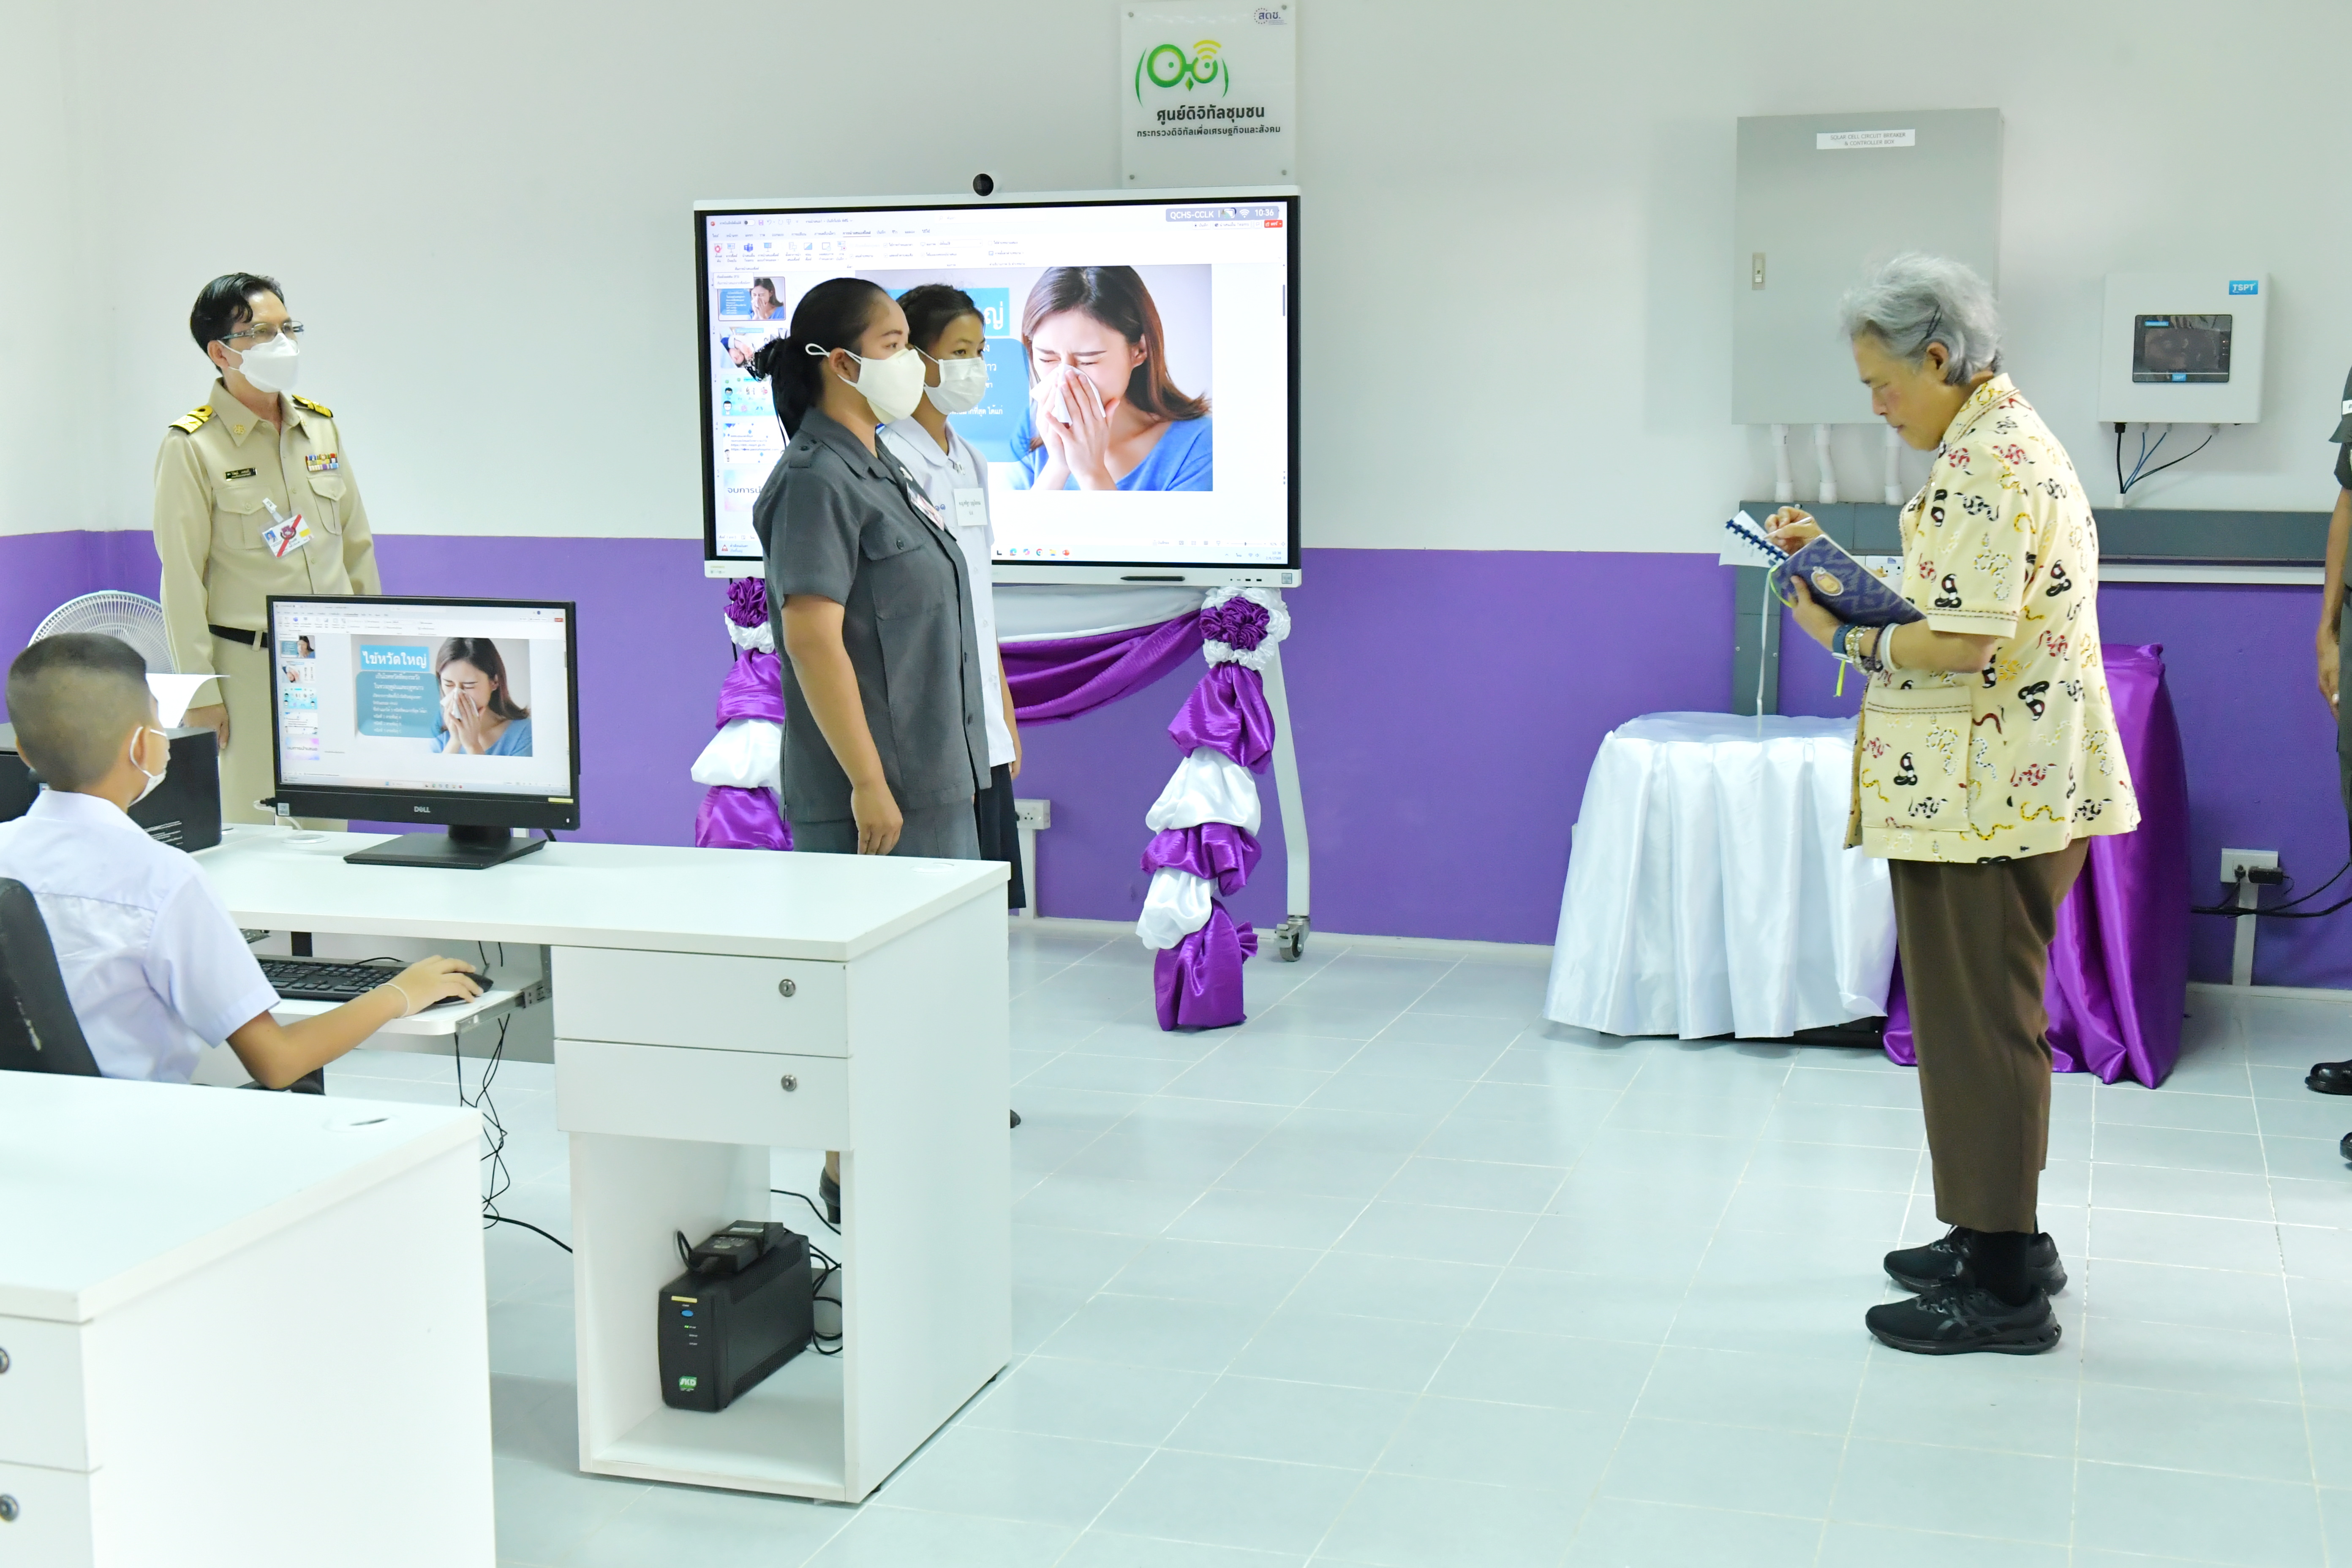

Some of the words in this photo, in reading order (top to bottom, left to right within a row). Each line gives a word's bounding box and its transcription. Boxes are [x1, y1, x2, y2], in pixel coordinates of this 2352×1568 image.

[1157, 104, 1265, 125] ศูนย์ดิจิทัลชุมชน
[1137, 125, 1281, 137] กระทรวงดิจิทัลเพื่อเศรษฐกิจและสังคม
[1170, 210, 1214, 219] QCHS-CCLK
[1255, 209, 1274, 217] 10:36
[362, 650, 427, 669] ไข้หวัดใหญ่
